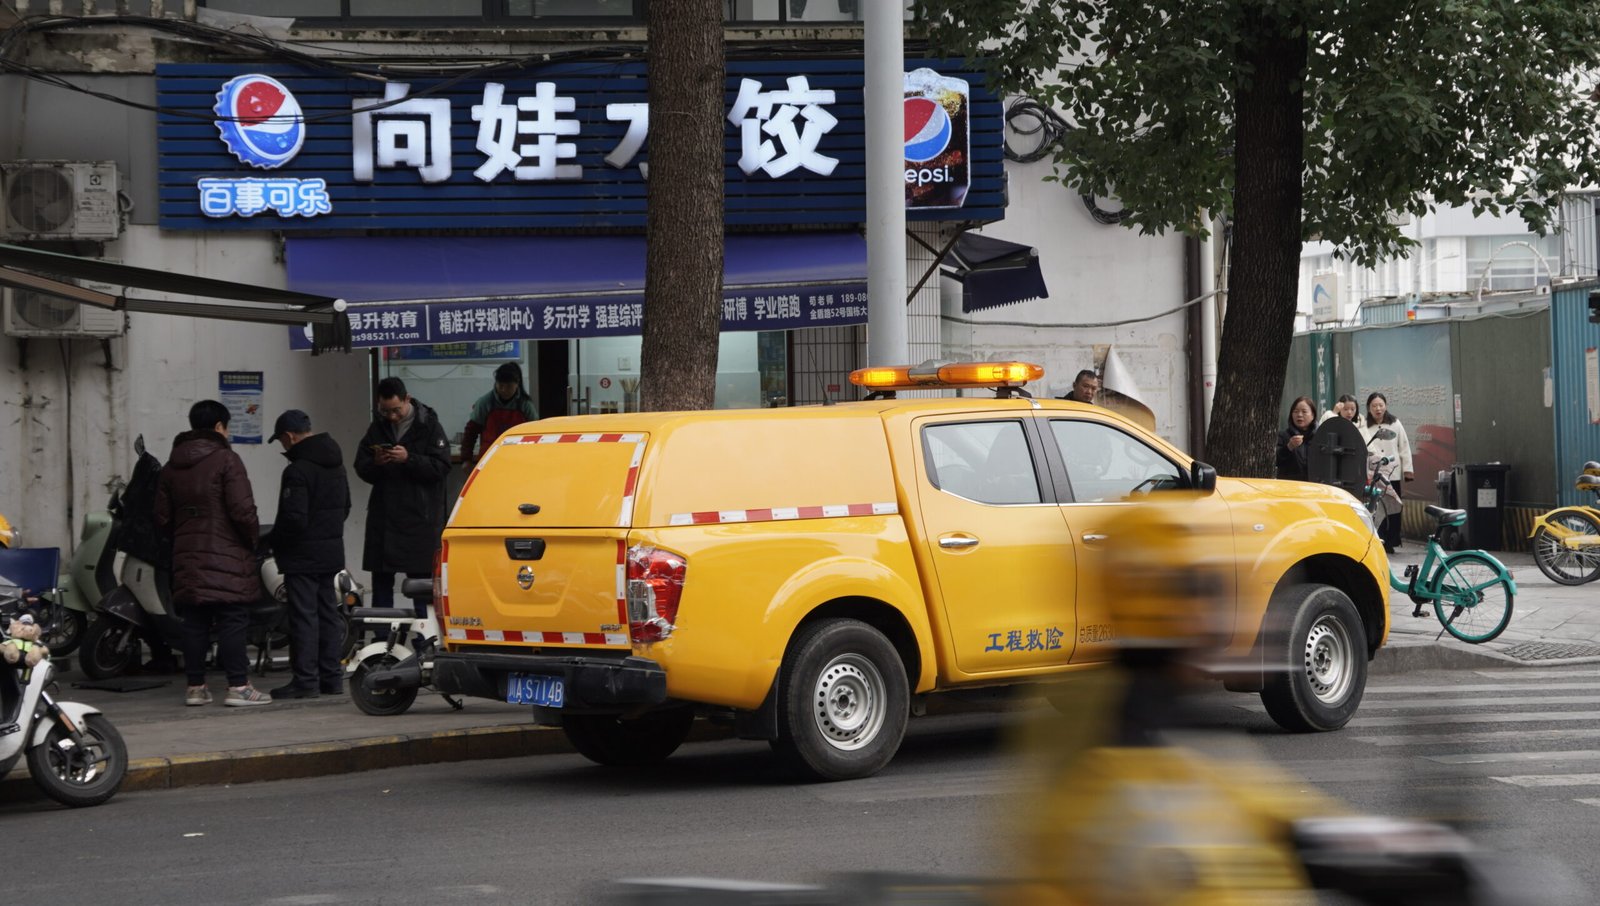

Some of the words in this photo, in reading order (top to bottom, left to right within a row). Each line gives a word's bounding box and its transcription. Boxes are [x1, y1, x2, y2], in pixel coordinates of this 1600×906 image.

[904, 164, 950, 187] epsi
[198, 179, 331, 216] 百事可乐
[841, 292, 868, 304] 189-08
[347, 310, 418, 330] 易升教育
[438, 306, 535, 334] 精准升学规划中心
[543, 304, 591, 330] 多元升学
[595, 303, 644, 329] 强基综评
[720, 297, 748, 321] 研博
[754, 294, 801, 321] 学业陪跑
[809, 305, 868, 320] 金盾路52号国栋大
[352, 331, 420, 342] es985211.com
[985, 626, 1064, 653] 工程救险
